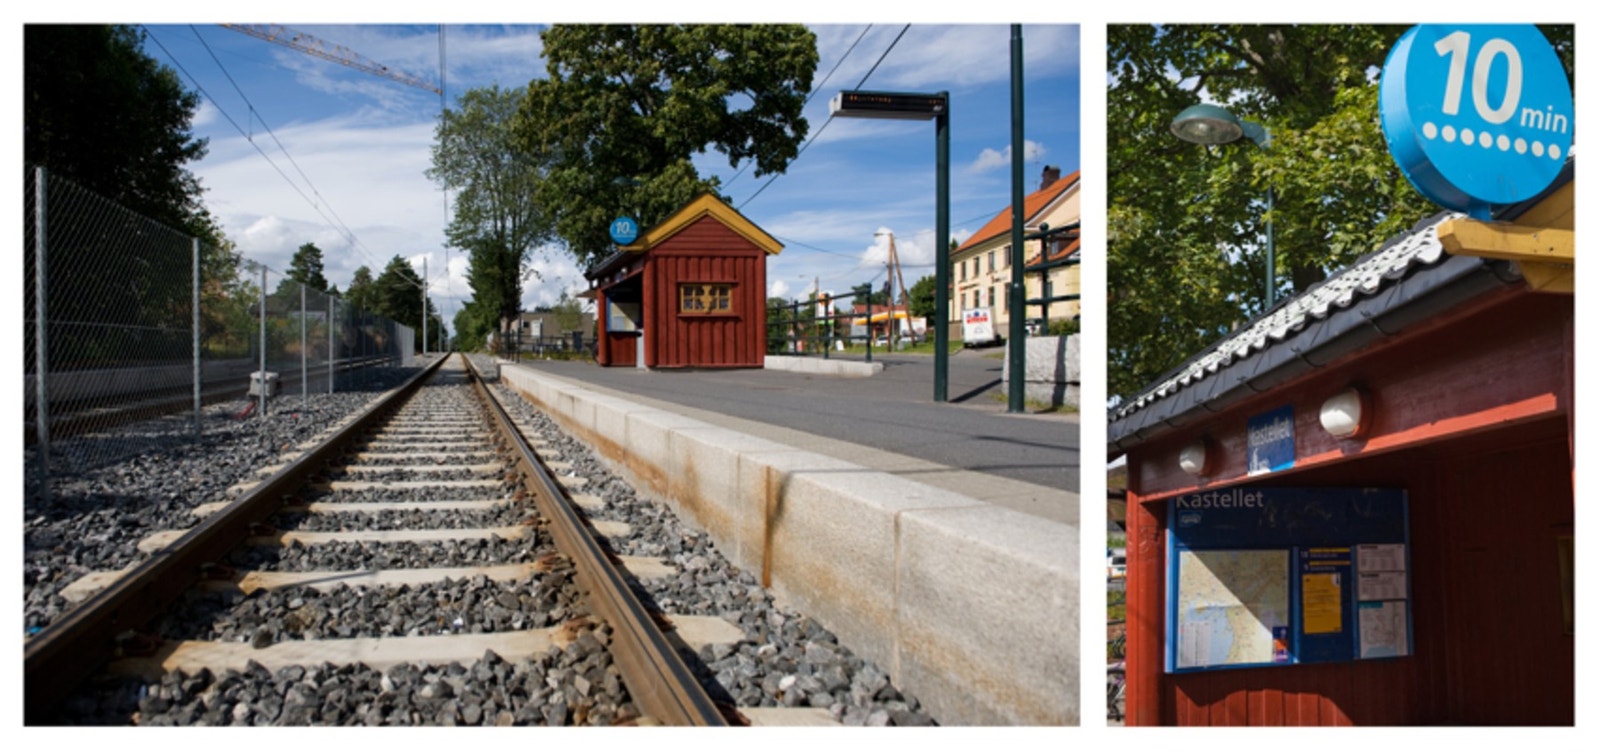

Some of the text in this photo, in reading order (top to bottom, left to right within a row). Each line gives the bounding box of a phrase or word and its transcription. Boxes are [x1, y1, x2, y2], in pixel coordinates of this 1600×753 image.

[1434, 30, 1568, 135] 10 min
[615, 221, 630, 234] 10
[1176, 489, 1264, 509] Kastellet
